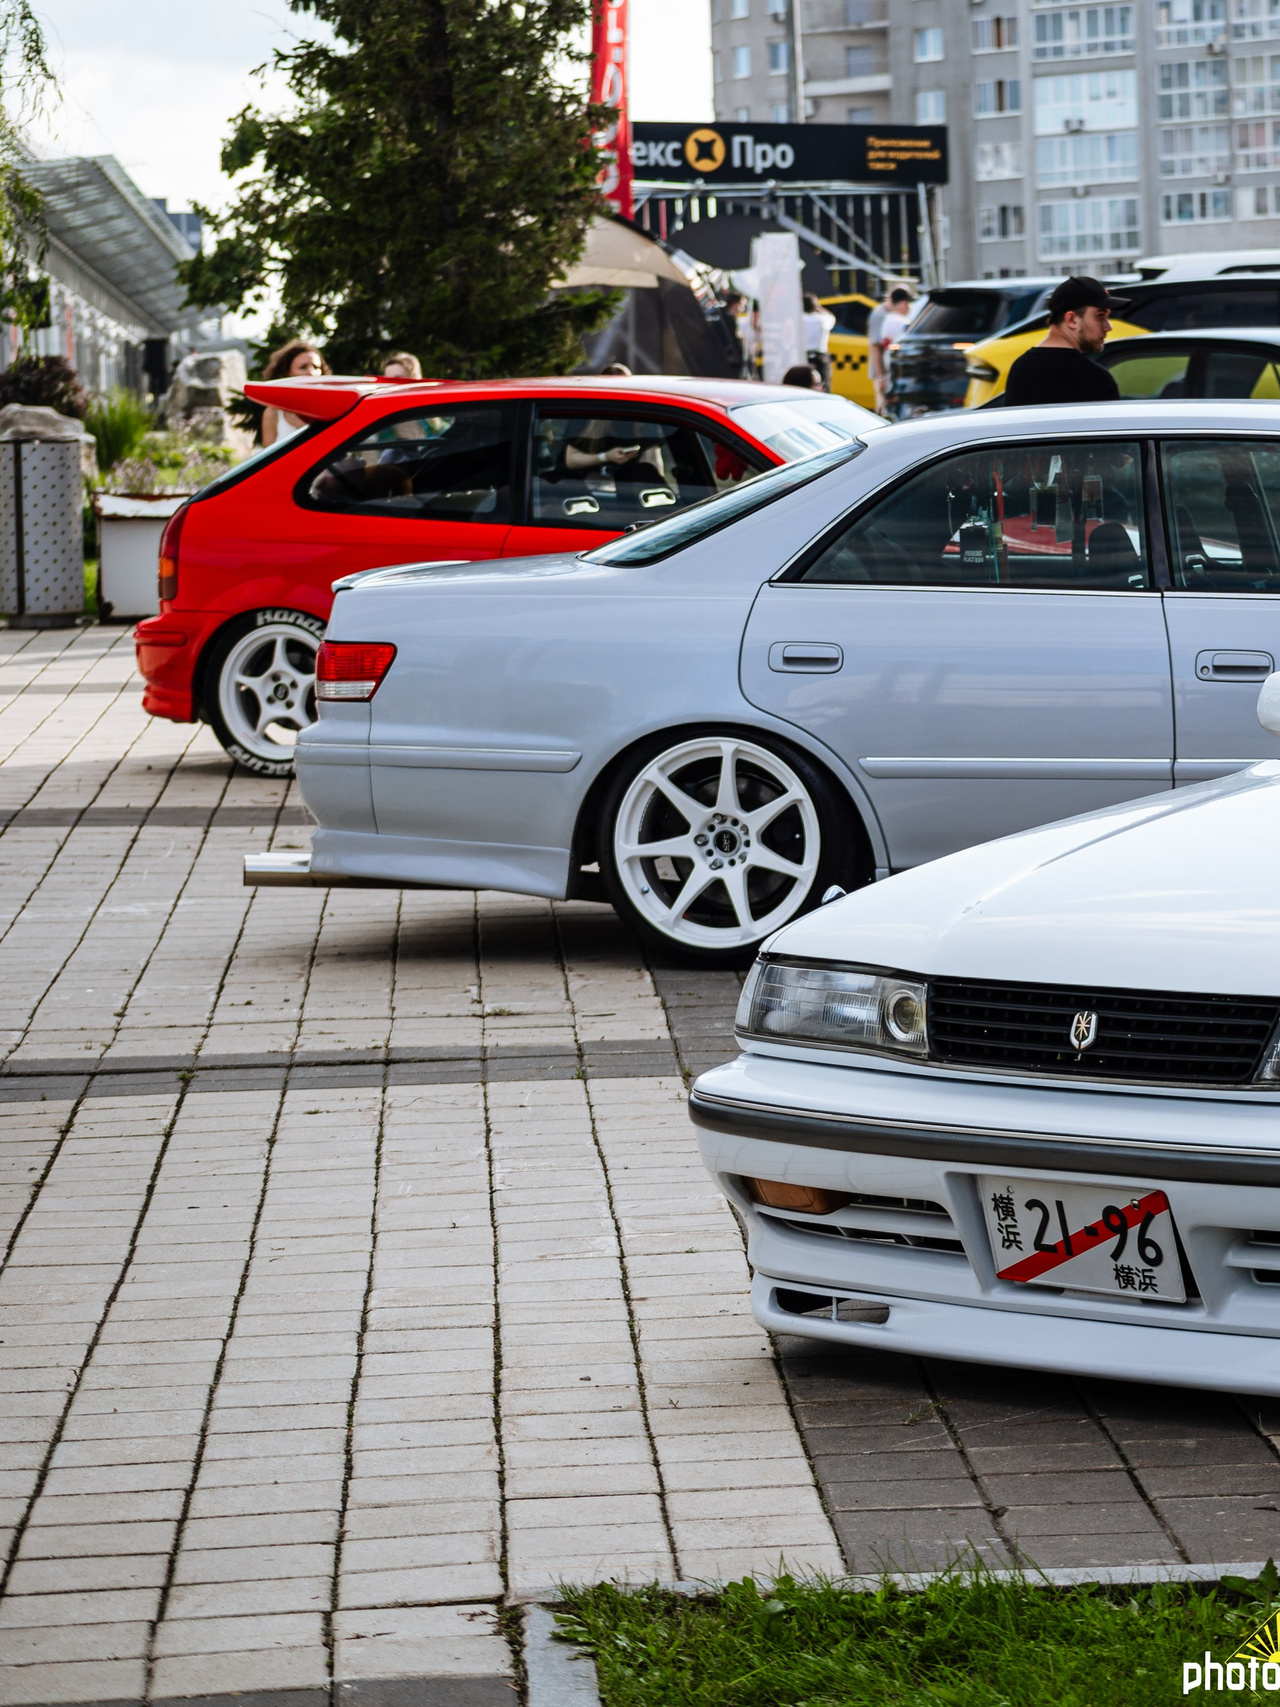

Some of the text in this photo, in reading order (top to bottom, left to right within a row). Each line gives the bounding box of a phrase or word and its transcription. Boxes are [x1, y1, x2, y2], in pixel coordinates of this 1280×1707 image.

[731, 134, 795, 174] Про
[991, 1193, 1024, 1252] 横浜
[1112, 1263, 1159, 1294] 横浜
